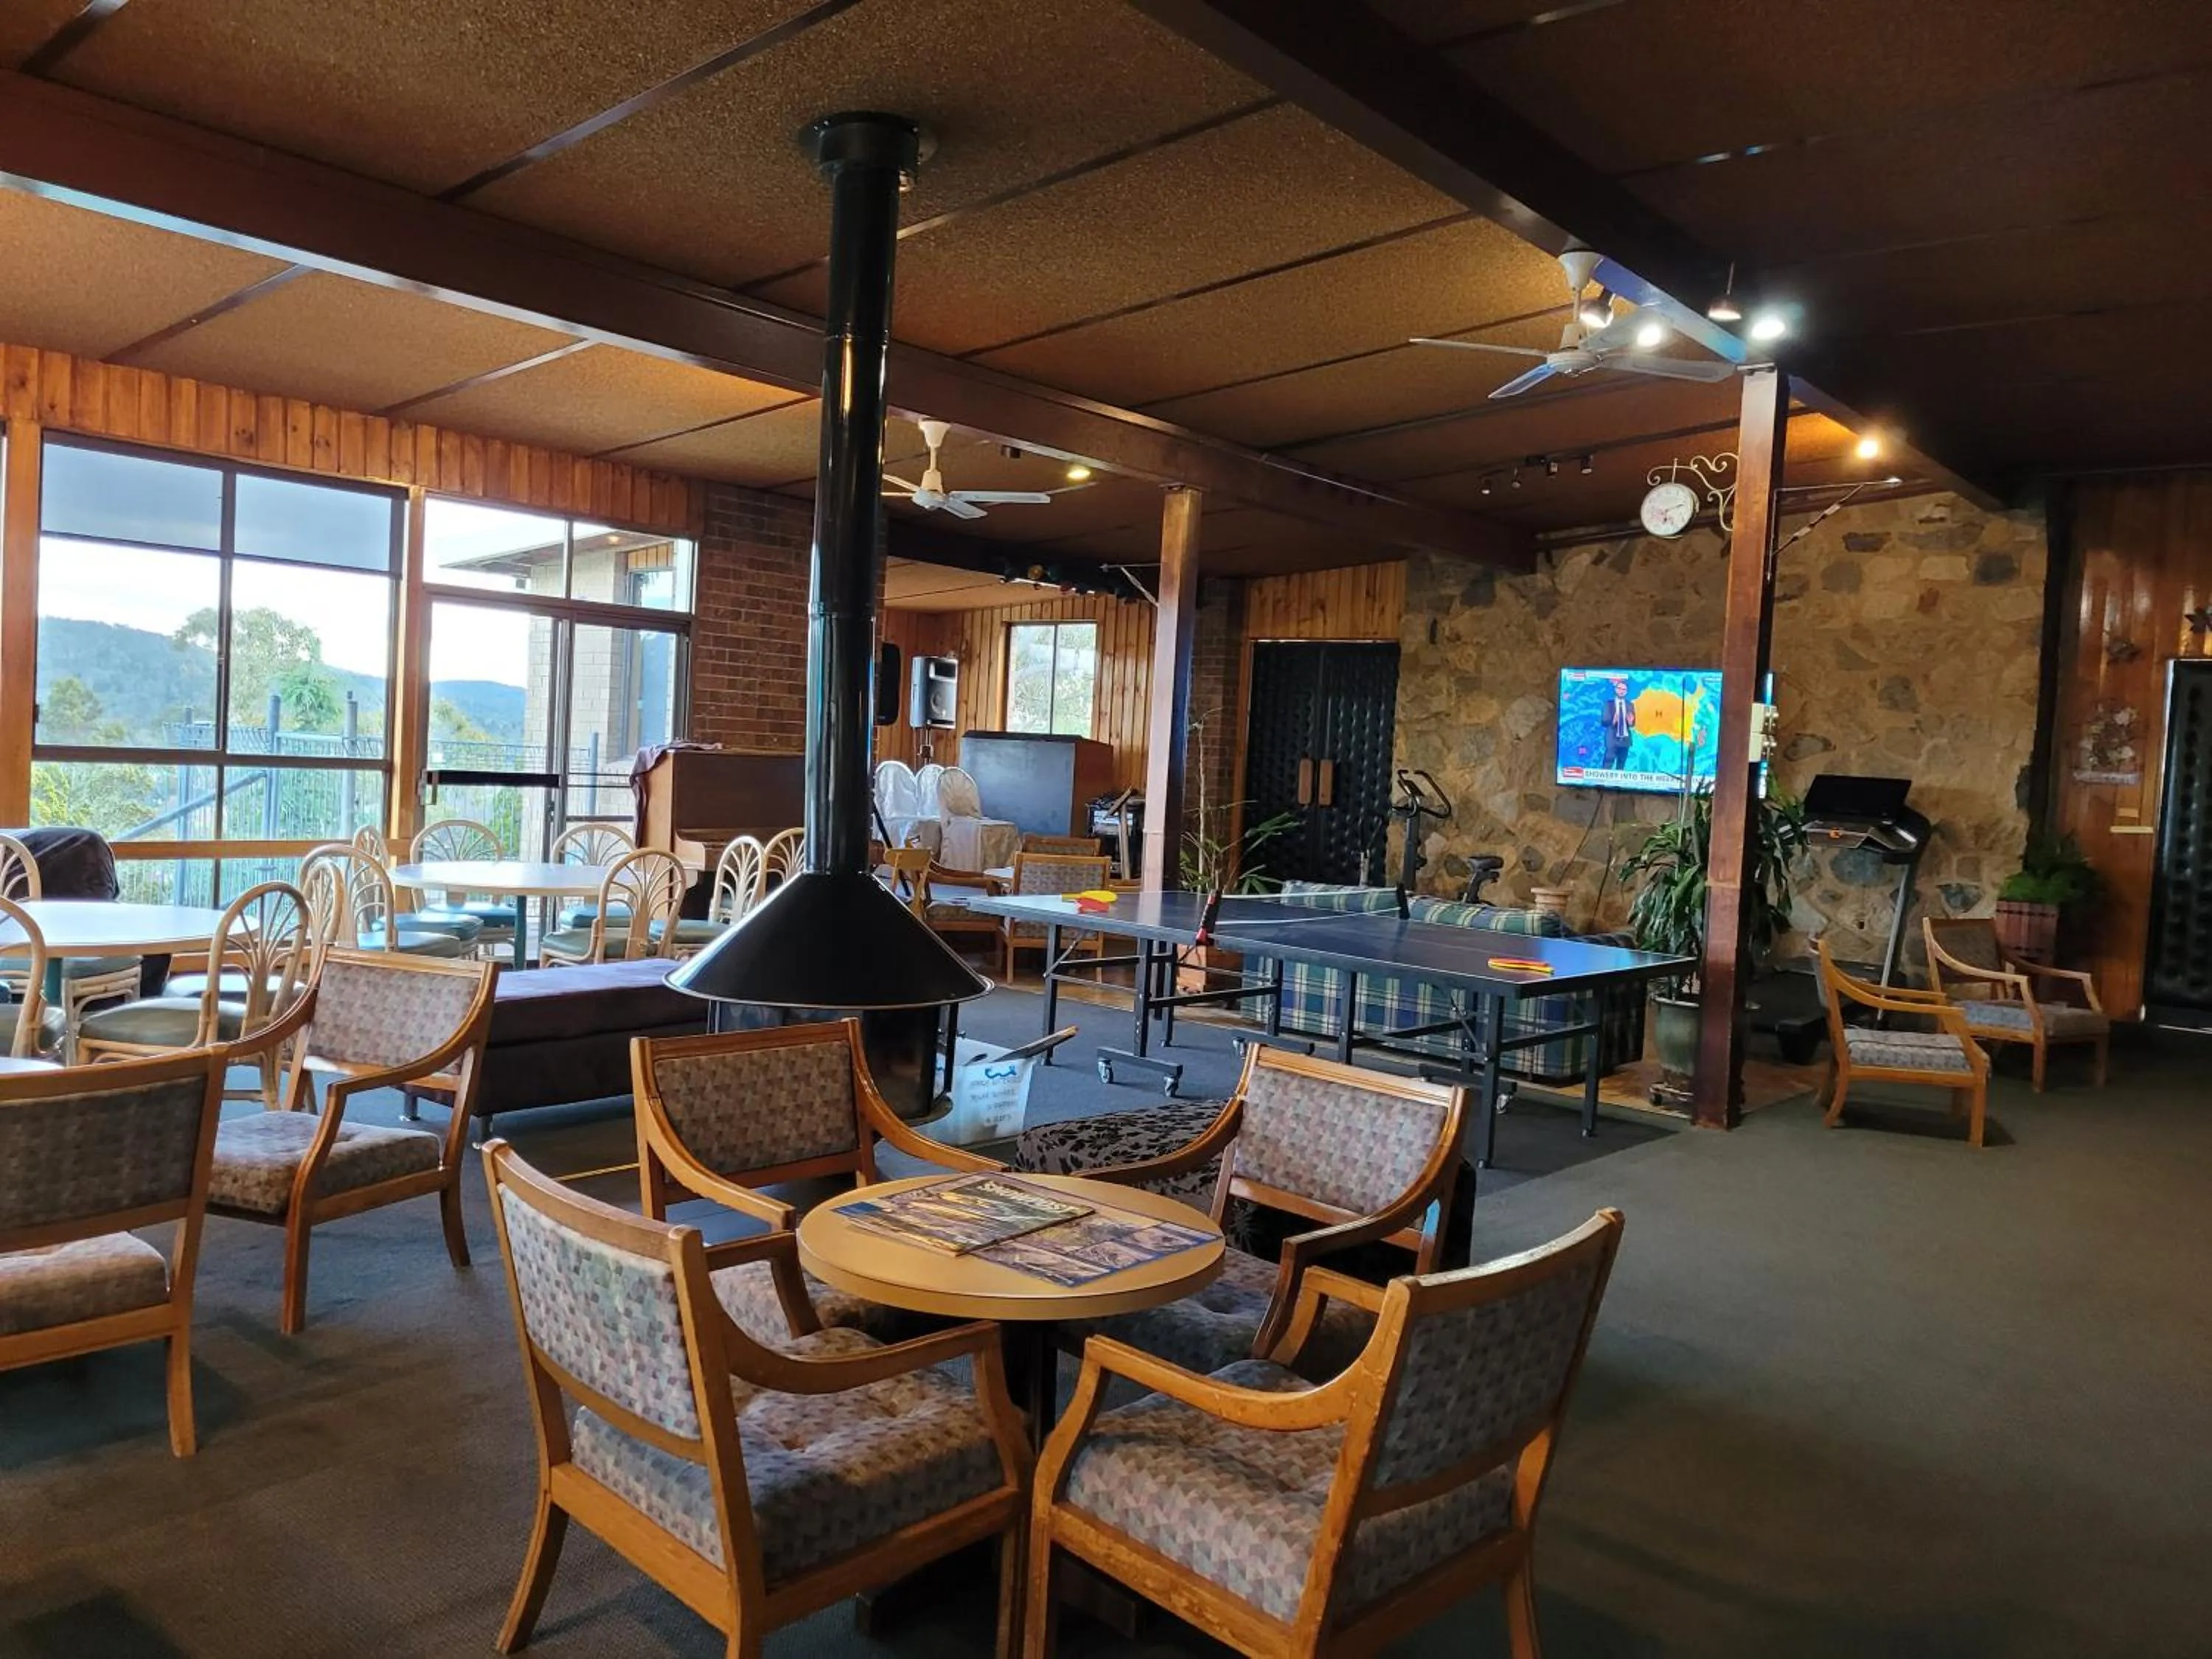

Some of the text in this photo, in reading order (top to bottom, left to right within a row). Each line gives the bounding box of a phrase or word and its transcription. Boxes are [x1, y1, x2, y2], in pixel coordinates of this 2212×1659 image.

[1585, 770, 1618, 779] SHOWERY
[1620, 772, 1638, 780] INTO
[1640, 773, 1654, 782] THE
